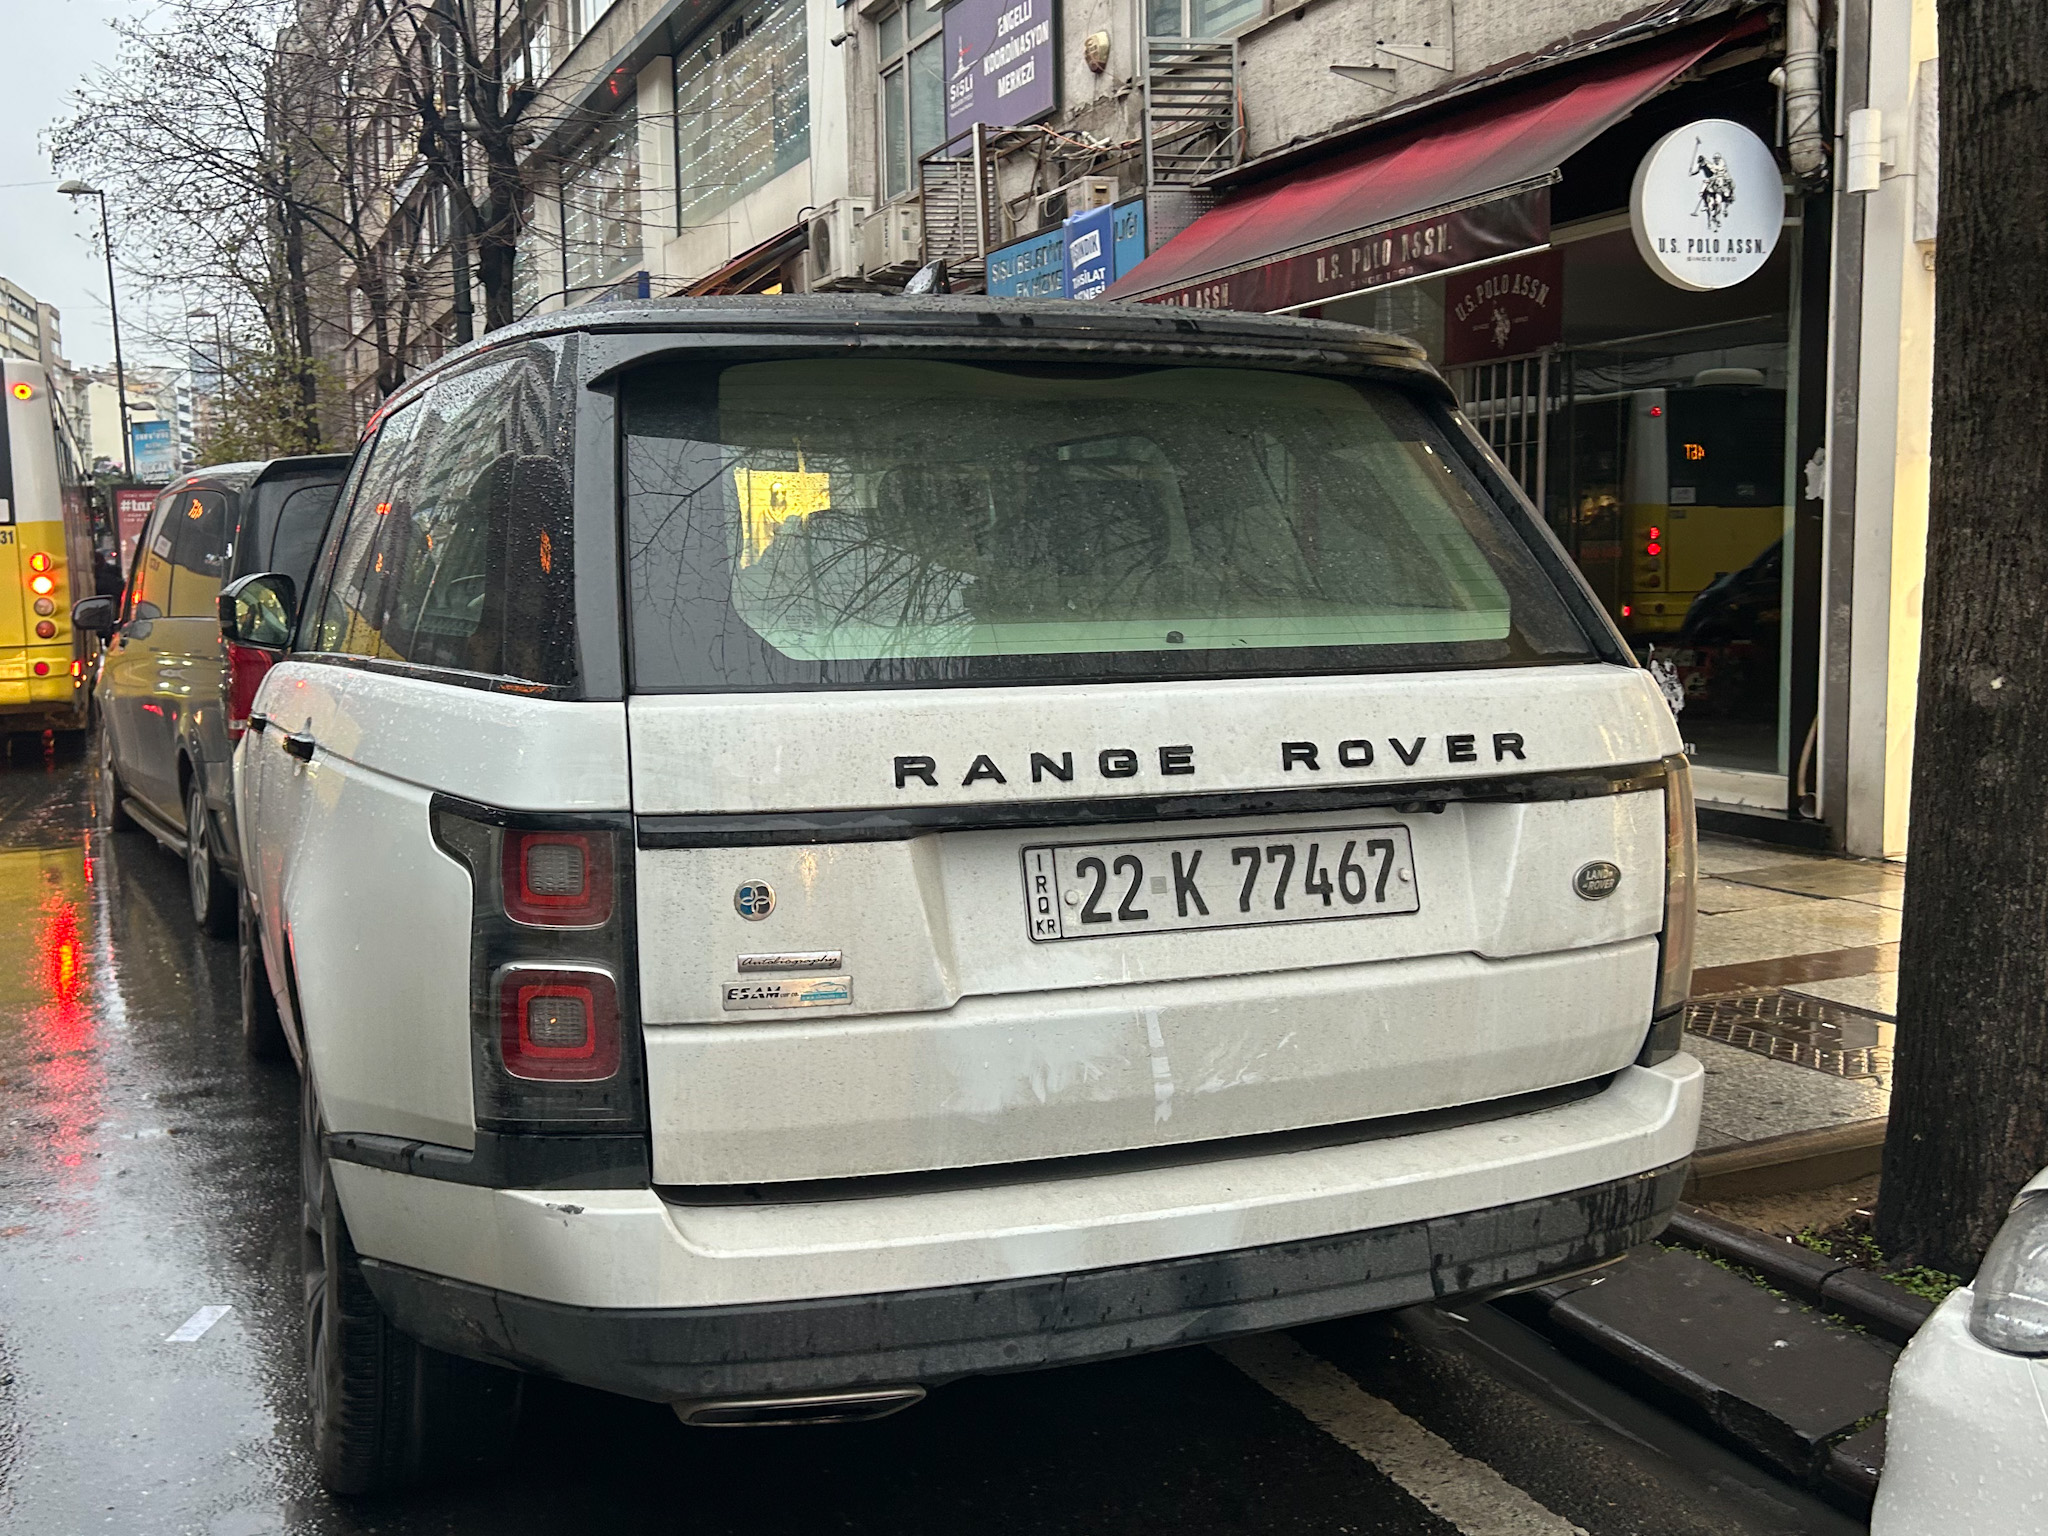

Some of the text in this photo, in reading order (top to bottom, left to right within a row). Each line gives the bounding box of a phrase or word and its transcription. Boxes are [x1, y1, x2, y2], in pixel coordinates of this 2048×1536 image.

[998, 56, 1035, 98] MERKEZİ
[1316, 223, 1452, 283] U.S. POLO ASSN.
[1658, 238, 1681, 253] U.S.
[1688, 239, 1720, 253] POLO
[1455, 295, 1478, 321] U.S.
[1475, 274, 1510, 304] POLO
[0, 530, 14, 545] 31
[894, 732, 1528, 789] RANGE ROVER
[1075, 855, 1149, 924] 22
[1172, 850, 1210, 917] K
[1231, 838, 1395, 913] 77467
[1586, 878, 1615, 890] ROVER
[1035, 918, 1057, 935] KR
[741, 955, 839, 967] Autobiography
[727, 986, 781, 1000] ESAM
